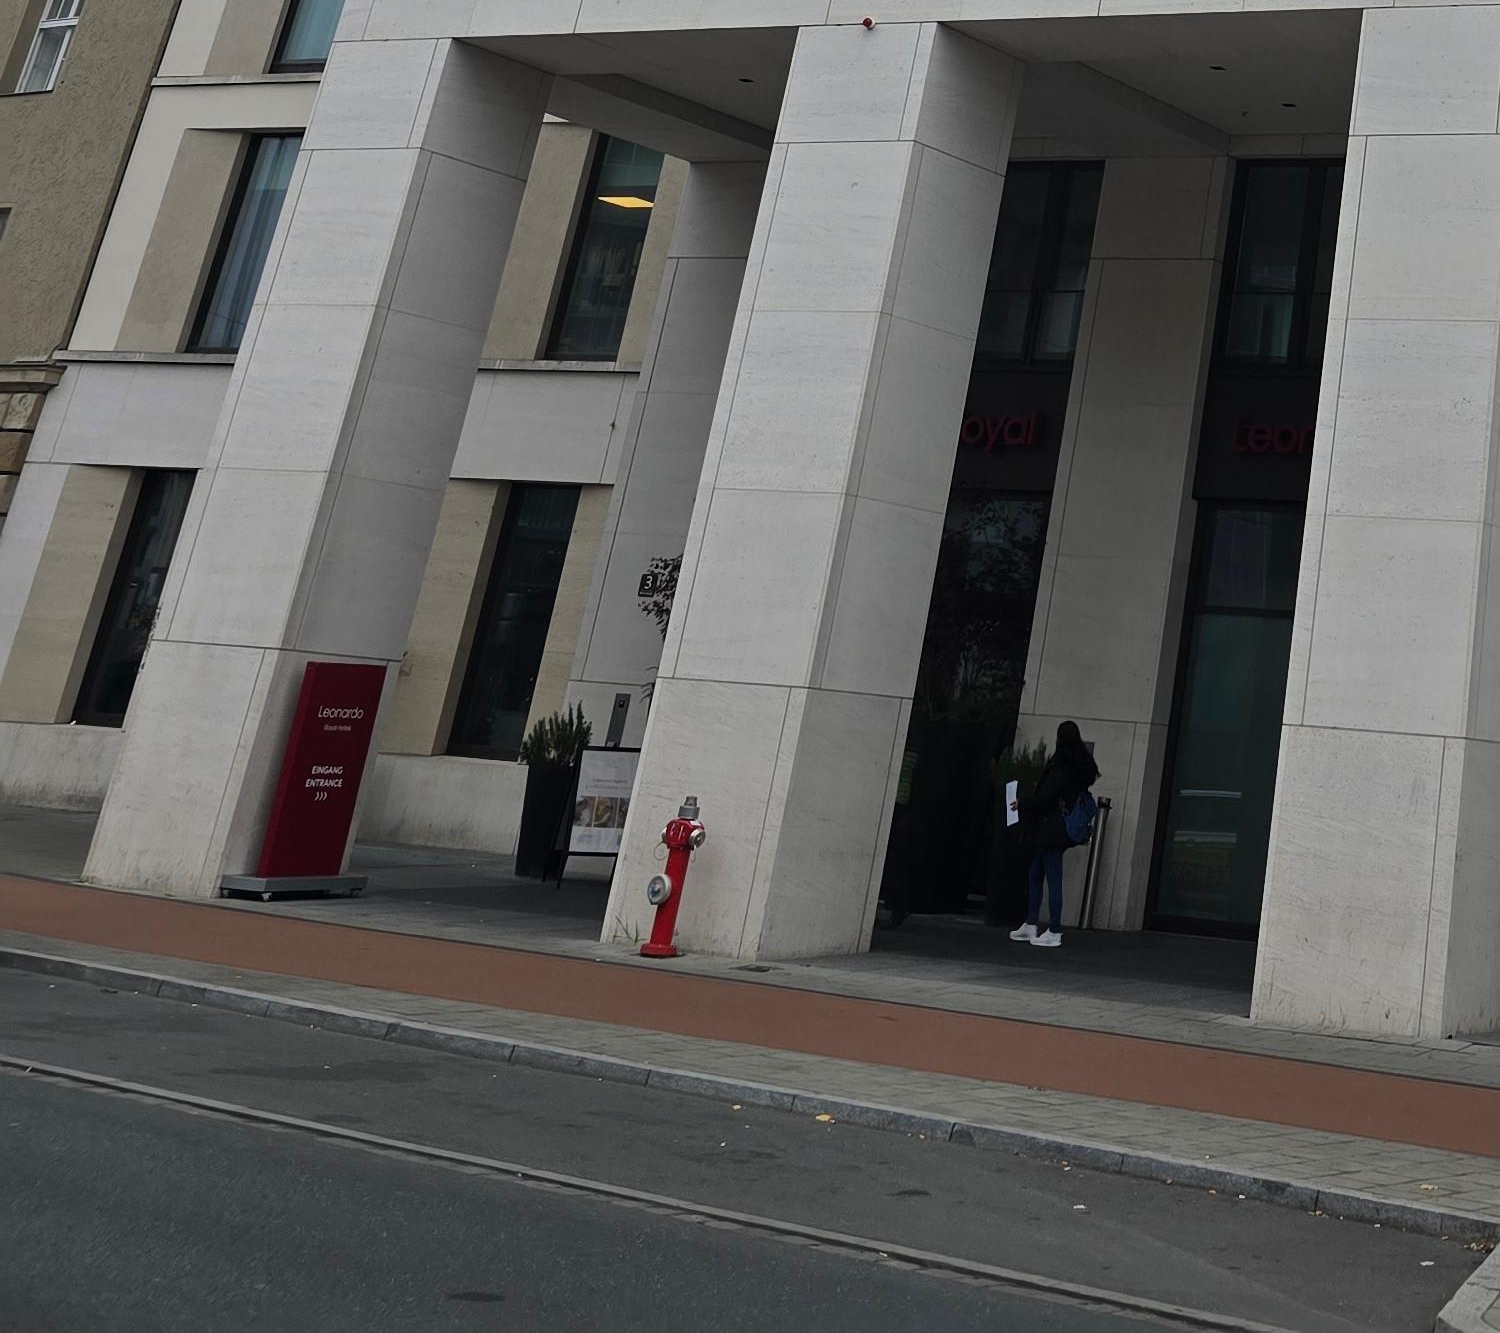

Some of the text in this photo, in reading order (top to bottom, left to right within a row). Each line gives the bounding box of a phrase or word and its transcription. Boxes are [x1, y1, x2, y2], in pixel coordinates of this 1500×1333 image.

[644, 575, 654, 590] 3
[318, 705, 363, 719] Leonardo
[311, 766, 343, 774] EINGANG
[305, 779, 342, 787] ENTRANCE
